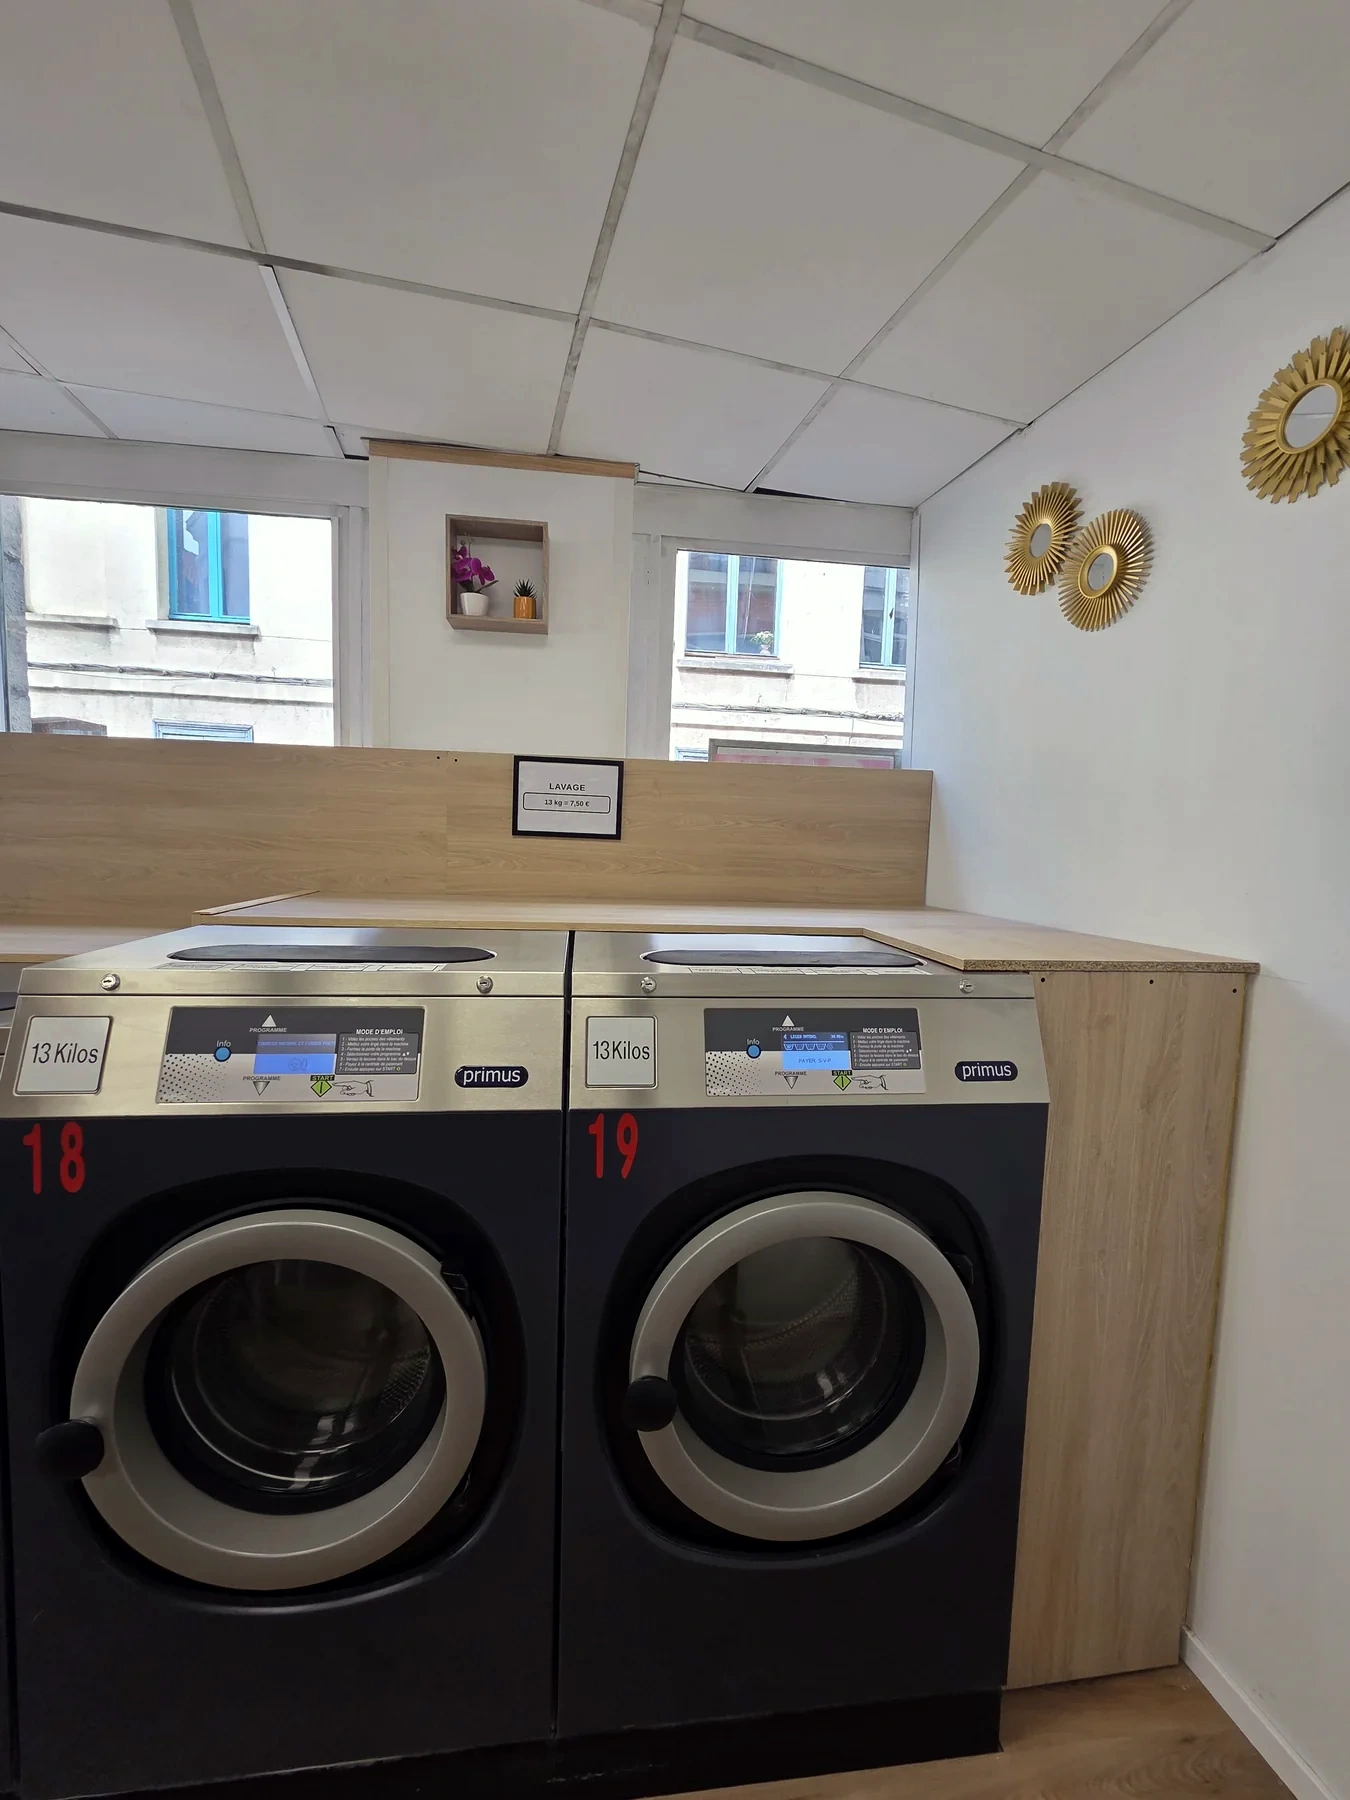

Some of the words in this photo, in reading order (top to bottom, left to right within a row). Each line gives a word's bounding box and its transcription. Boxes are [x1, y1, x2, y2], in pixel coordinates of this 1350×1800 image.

[549, 783, 586, 791] LAVAGE
[554, 799, 563, 807] kg
[216, 1040, 231, 1048] Info
[463, 1067, 520, 1086] primus
[962, 1062, 1012, 1080] primus
[588, 1112, 639, 1180] 19
[22, 1121, 86, 1194] 18
